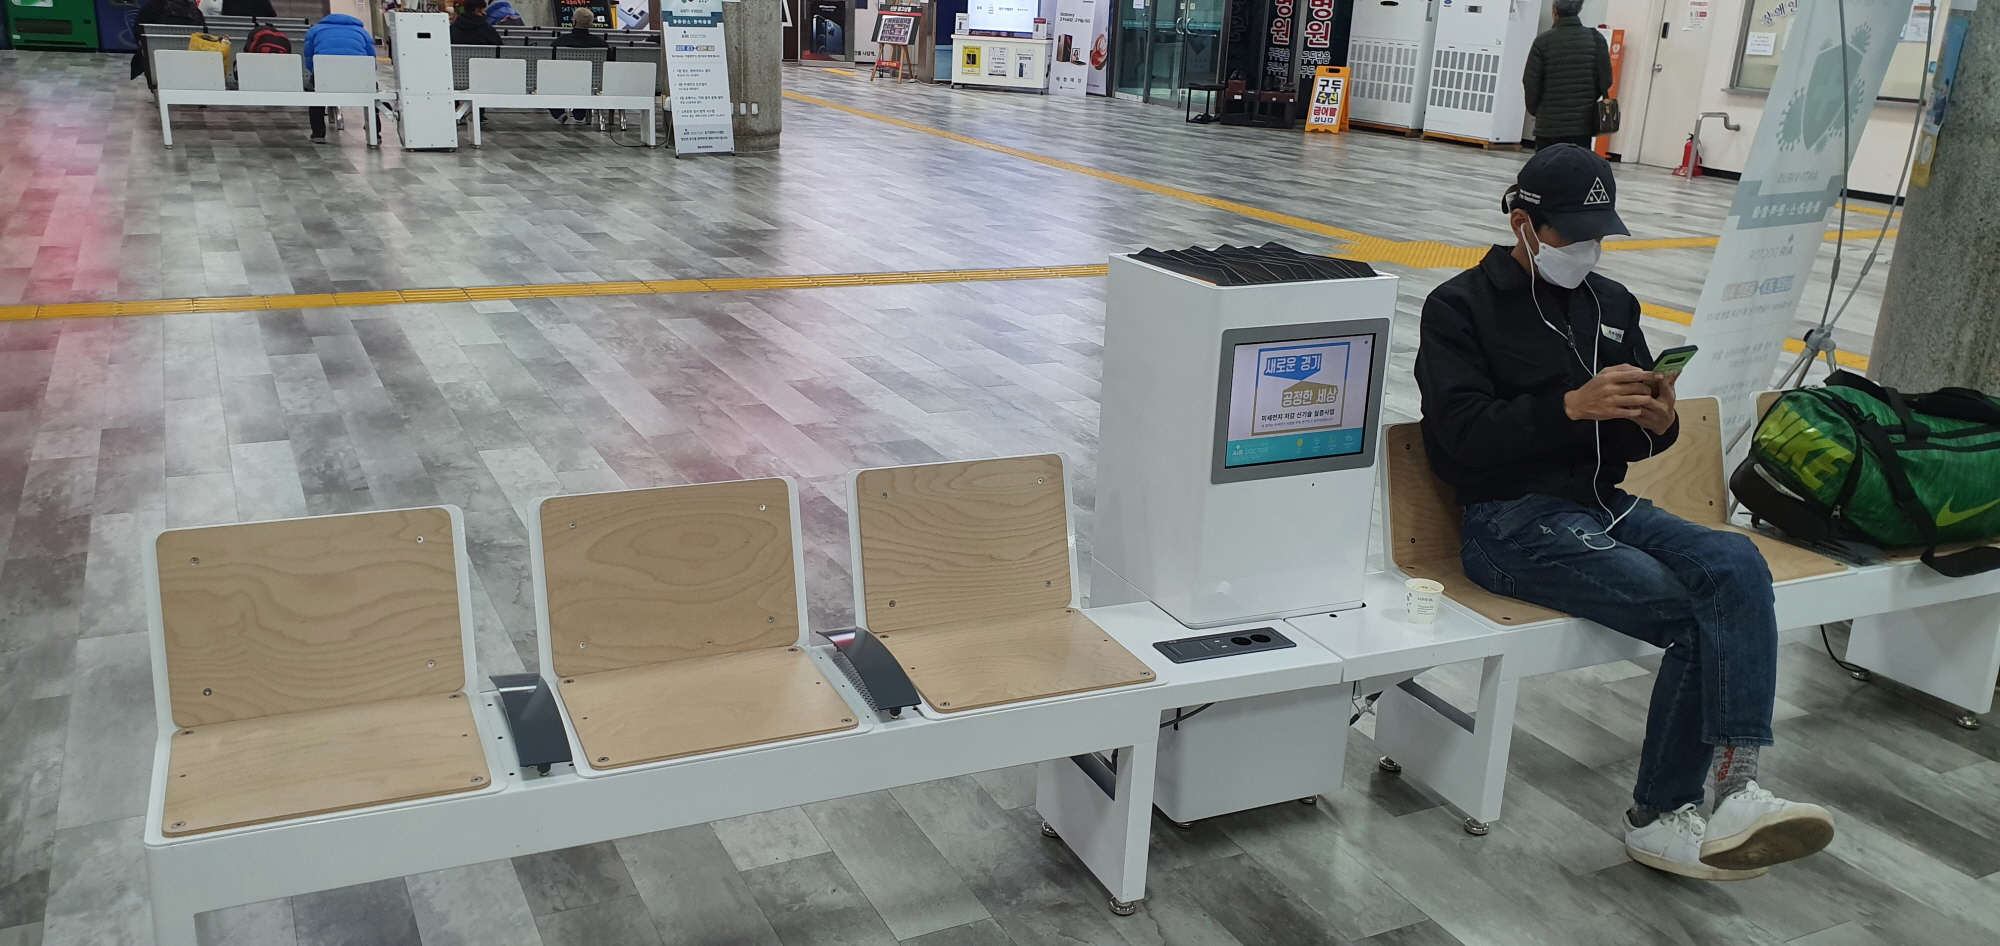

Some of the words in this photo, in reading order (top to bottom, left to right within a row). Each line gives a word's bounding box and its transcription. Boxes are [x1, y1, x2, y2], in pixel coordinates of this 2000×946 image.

[1319, 79, 1341, 92] 구두
[1317, 92, 1338, 104] 수선
[1265, 357, 1296, 374] 새로운
[1300, 355, 1322, 371] 경기
[1282, 389, 1313, 407] 공정한
[1316, 387, 1338, 403] 세상
[1261, 413, 1282, 422] 미세먼지
[1314, 408, 1335, 416] 실증사업
[1244, 447, 1269, 455] DOCTOR
[1753, 401, 1855, 490] NIKE
